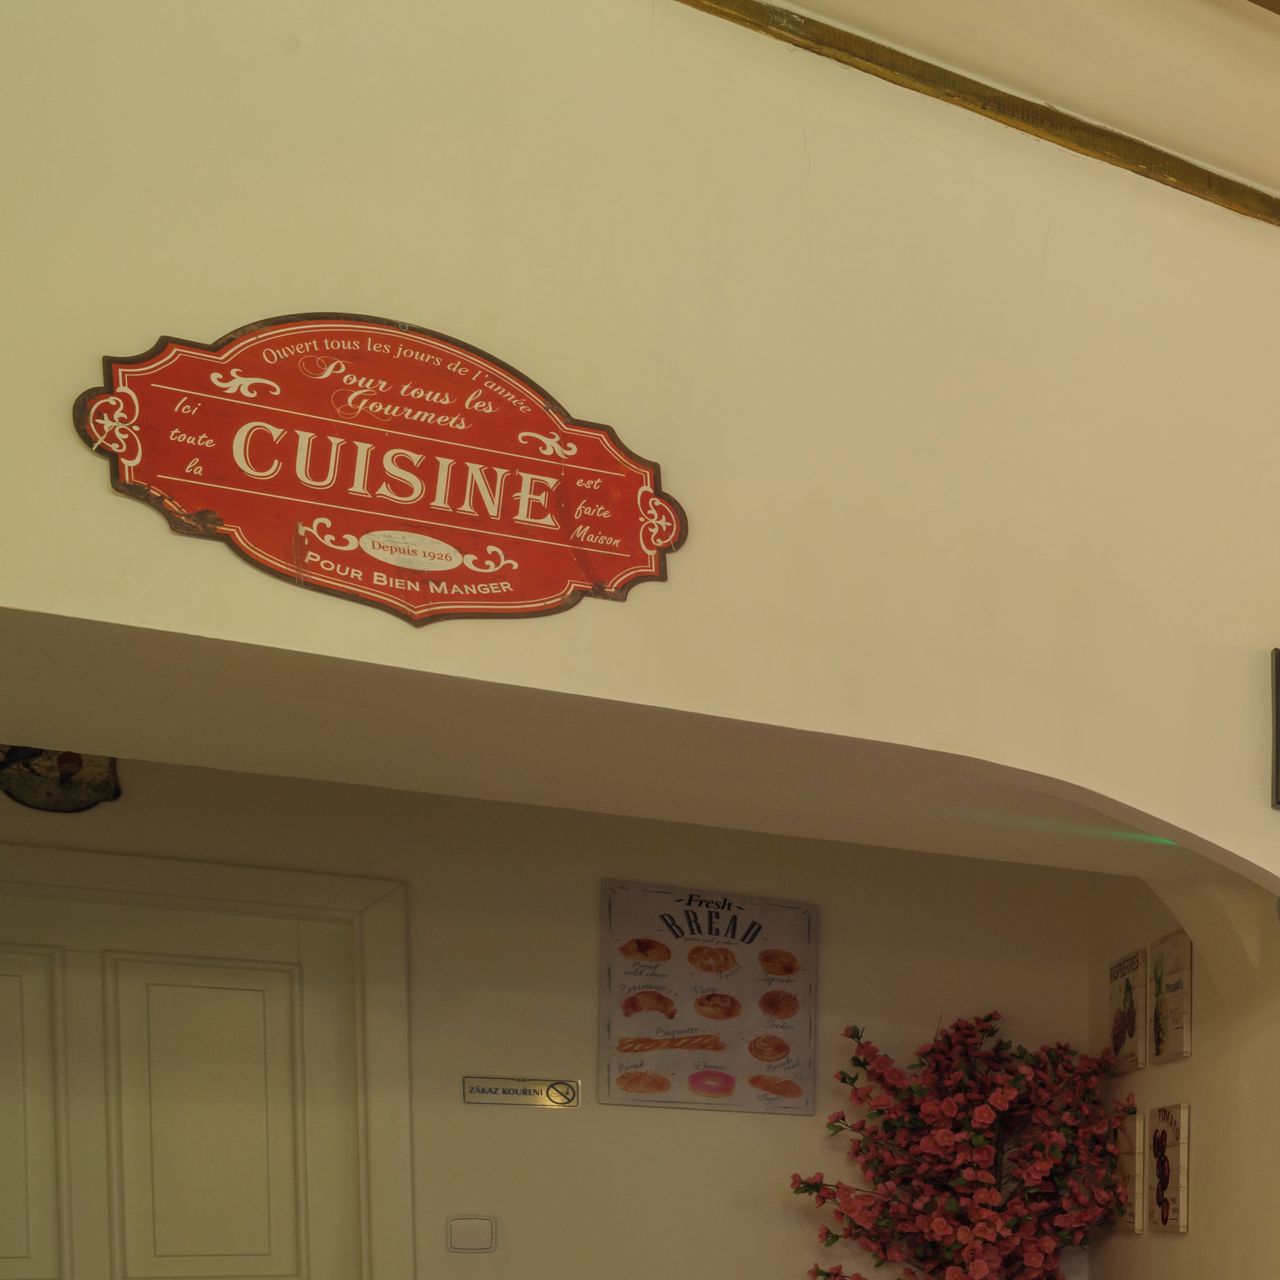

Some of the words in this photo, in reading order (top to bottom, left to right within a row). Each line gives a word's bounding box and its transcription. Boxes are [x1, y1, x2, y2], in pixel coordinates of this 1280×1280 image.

[262, 338, 319, 364] Ouvert
[323, 338, 360, 351] tous
[367, 337, 391, 353] les
[393, 343, 443, 367] jours
[447, 361, 469, 376] de
[472, 370, 532, 414] l'année
[298, 355, 393, 393] Pour
[400, 381, 458, 405] tous
[465, 390, 499, 414] les
[174, 396, 202, 416] Ici
[331, 388, 473, 430] Gourmets
[169, 427, 215, 448] toute
[185, 457, 205, 476] la
[232, 421, 562, 530] CUISINE
[576, 477, 603, 491] est
[574, 499, 612, 521] faite
[569, 526, 622, 549] Maison
[371, 539, 418, 560] Depuis
[421, 549, 453, 564] 1926
[685, 894, 732, 911] Fresh
[659, 909, 763, 945] BREAD
[469, 1085, 499, 1094] ZÁKAZ
[502, 1086, 543, 1096] KOUŘENÍ
